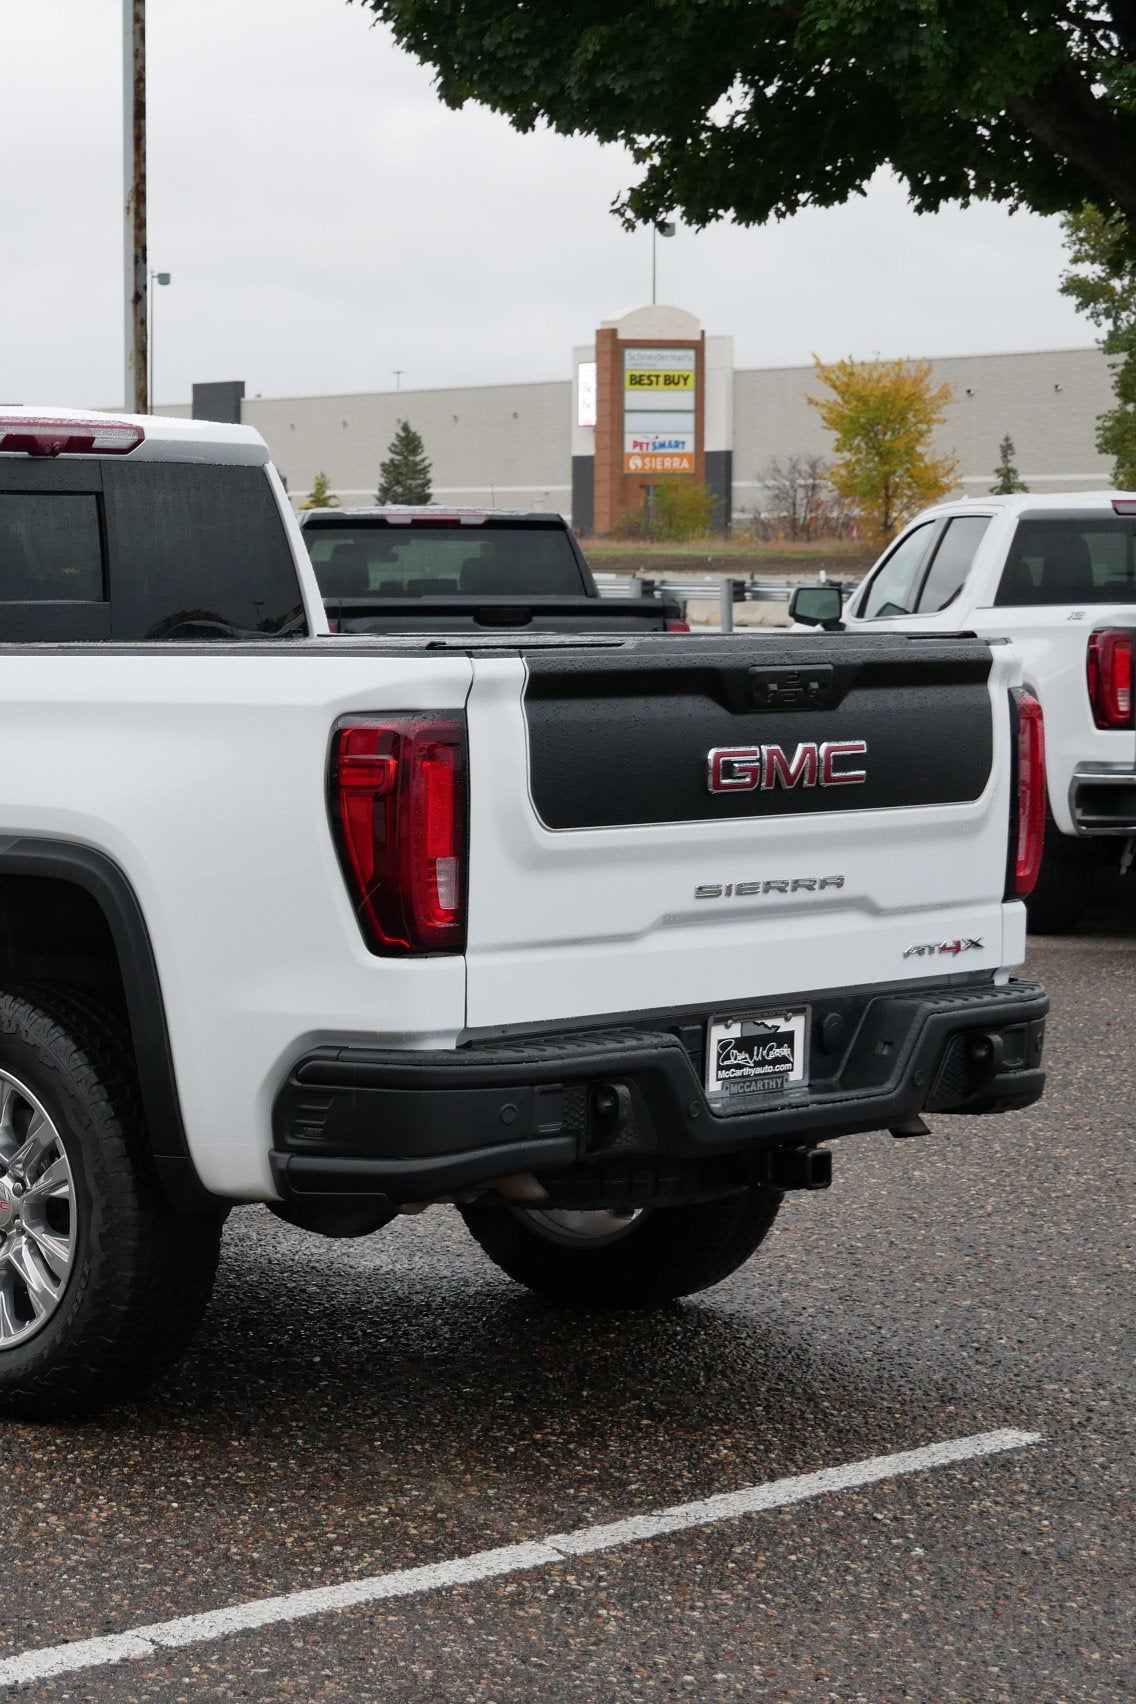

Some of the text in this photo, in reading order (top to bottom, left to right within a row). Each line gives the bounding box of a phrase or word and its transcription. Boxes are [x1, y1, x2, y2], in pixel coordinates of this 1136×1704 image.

[629, 374, 690, 386] BEST BUY
[644, 457, 689, 470] SIERRA
[708, 740, 867, 794] GMC
[694, 875, 845, 899] SIERRA
[902, 936, 985, 958] AT4X
[717, 1063, 793, 1079] McCarthyauto.com
[730, 1077, 784, 1095] MCCARTHY
